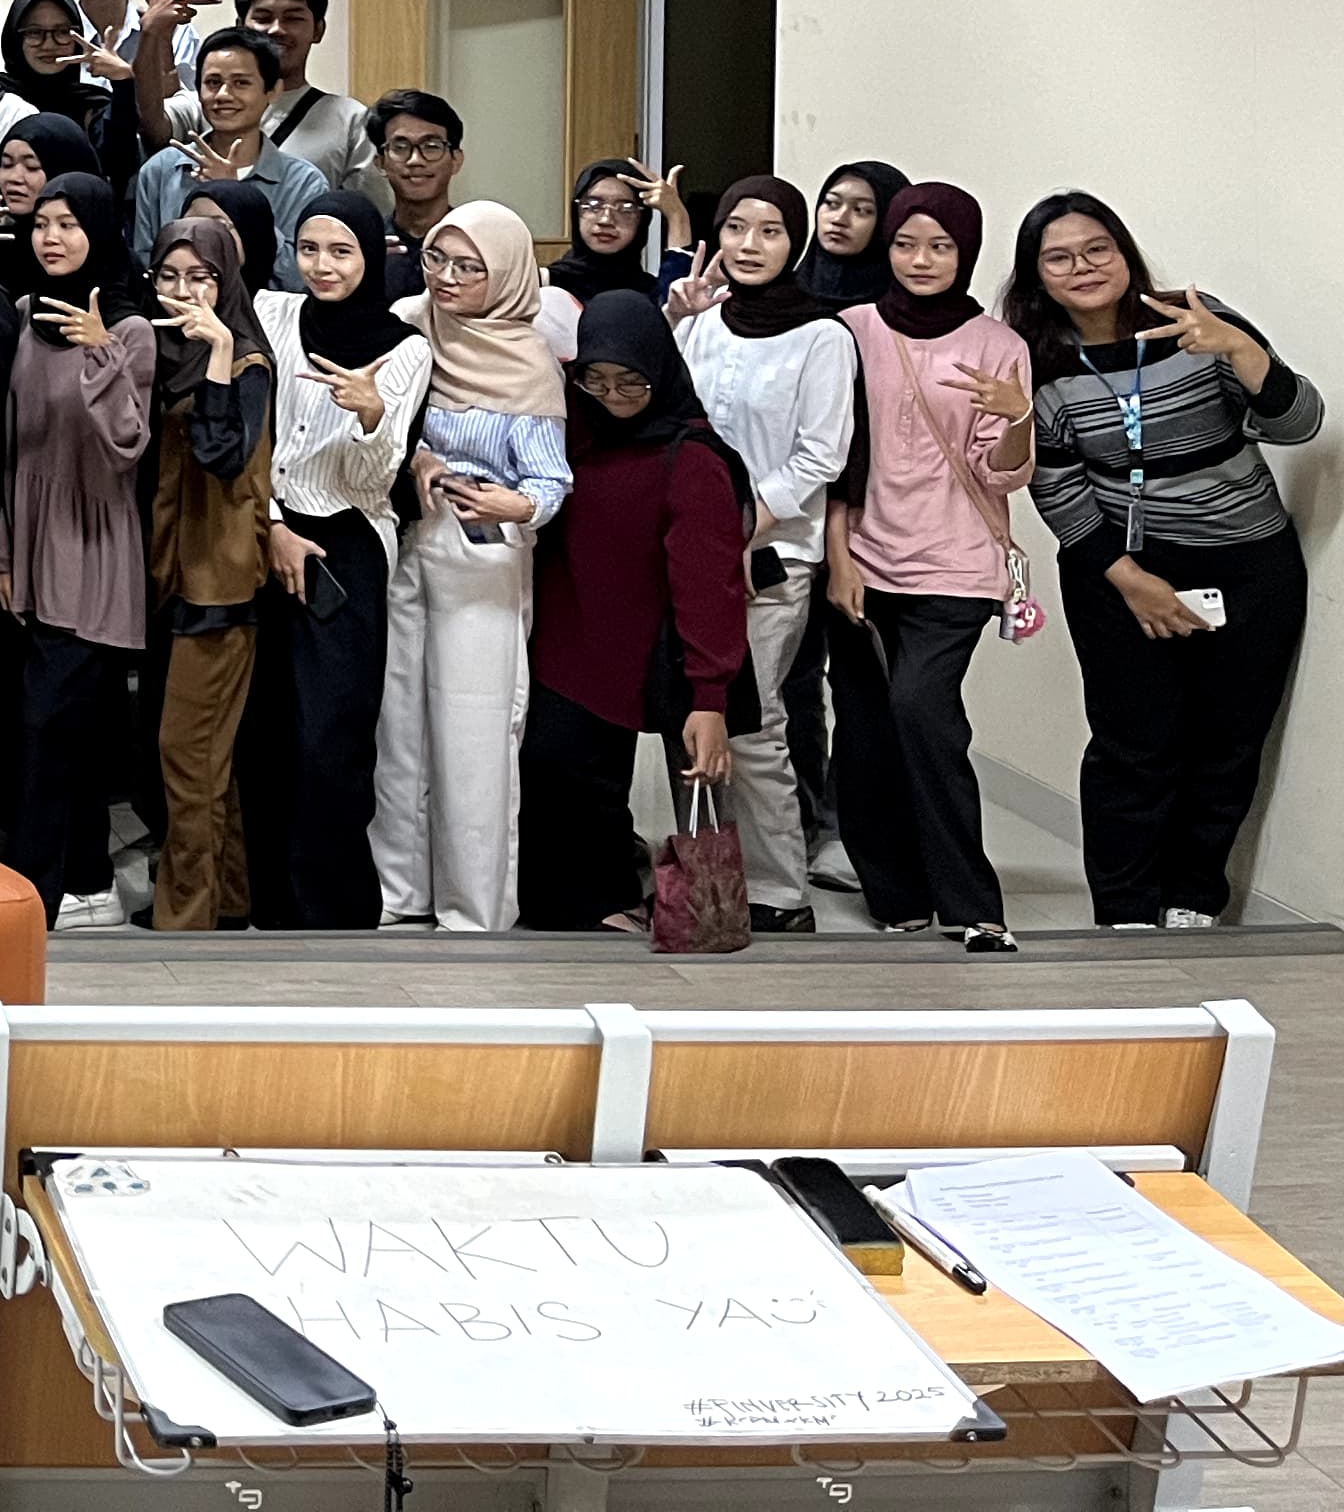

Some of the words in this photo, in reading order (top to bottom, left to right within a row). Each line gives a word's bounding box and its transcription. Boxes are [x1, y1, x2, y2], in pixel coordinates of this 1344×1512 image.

[221, 1216, 670, 1280] WAKTU
[286, 1293, 603, 1342] HABIS
[876, 1386, 947, 1403] 2025
